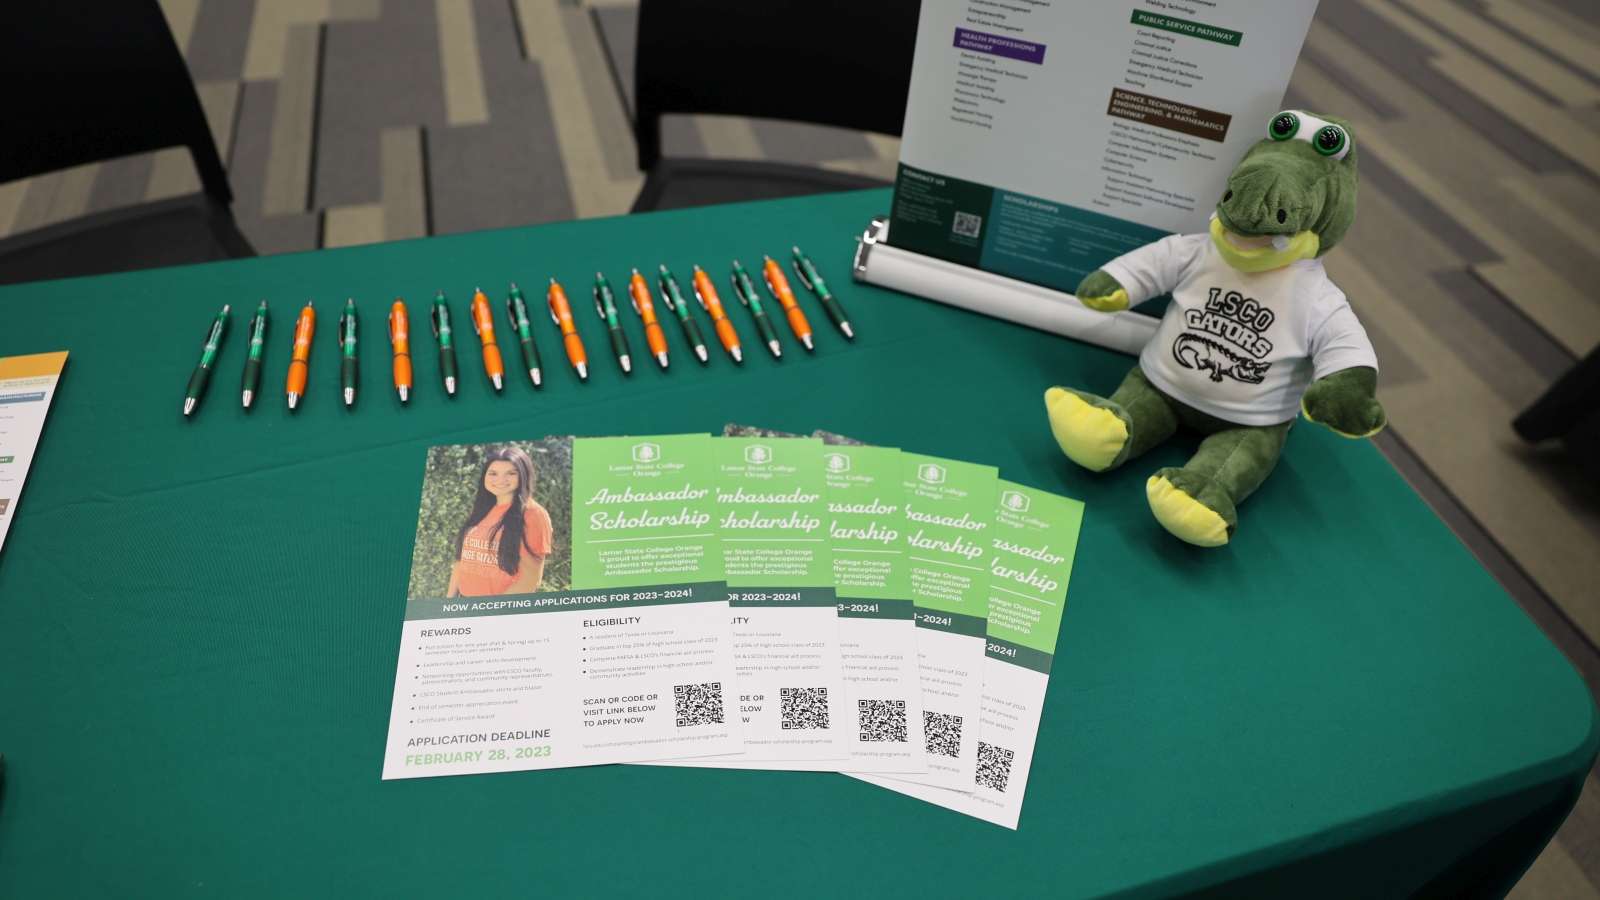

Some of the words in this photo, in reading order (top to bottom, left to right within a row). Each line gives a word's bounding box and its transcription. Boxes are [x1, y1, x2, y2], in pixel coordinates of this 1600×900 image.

[1168, 4, 1196, 14] Technology
[992, 23, 1024, 32] Management
[1139, 15, 1165, 27] PUBLIC
[1166, 20, 1195, 33] SERVICE
[1197, 27, 1233, 41] PATHWAY
[961, 32, 987, 43] HEALTH
[988, 37, 1036, 52] PROFESSIONS
[1135, 40, 1155, 48] Criminal
[1152, 33, 1175, 43] Reporting
[960, 40, 993, 51] PATHWAY
[1132, 49, 1152, 57] Criminal
[1170, 58, 1197, 68] Corrections
[1129, 59, 1155, 69] Emergency
[1157, 66, 1177, 74] Medical
[1178, 70, 1203, 80] Technician
[1125, 78, 1145, 88] Teaching
[1116, 91, 1146, 105] SCIENCE,
[1148, 99, 1198, 117] TECHNOLOGY,
[1111, 107, 1146, 120] PATHWAY
[1113, 100, 1164, 118] ENGINEERING,
[1173, 114, 1224, 130] MATHEMATICS
[1205, 287, 1275, 332] LSCO
[1185, 309, 1273, 359] GATORS
[826, 473, 844, 481] State
[585, 483, 708, 505] Ambassador
[717, 487, 819, 503] mbassador
[915, 488, 943, 499] Orange
[919, 483, 937, 492] State
[939, 487, 968, 497] College
[590, 507, 710, 530] Scholarship
[660, 551, 703, 560] exceptional
[606, 561, 639, 569] students
[848, 566, 890, 574] exceptional
[863, 560, 890, 568] Orange
[913, 568, 941, 577] College
[943, 573, 970, 582] Orange
[927, 576, 970, 588] exceptional
[918, 589, 963, 601] Scholarship.
[921, 581, 963, 595] prestigious
[472, 600, 531, 610] ACCEPTING
[534, 595, 607, 606] APPLICATIONS
[1014, 604, 1041, 615] Orange
[990, 612, 1031, 626] prestigious
[997, 607, 1040, 622] exceptional
[584, 617, 641, 627] ELIGIBILITY
[421, 628, 471, 637] REWARDS
[407, 734, 487, 746] APPLICATION
[491, 729, 550, 741] DEADLINE
[405, 751, 483, 766] FEBRUARY
[488, 749, 510, 760] 28,
[515, 746, 551, 758] 2023
